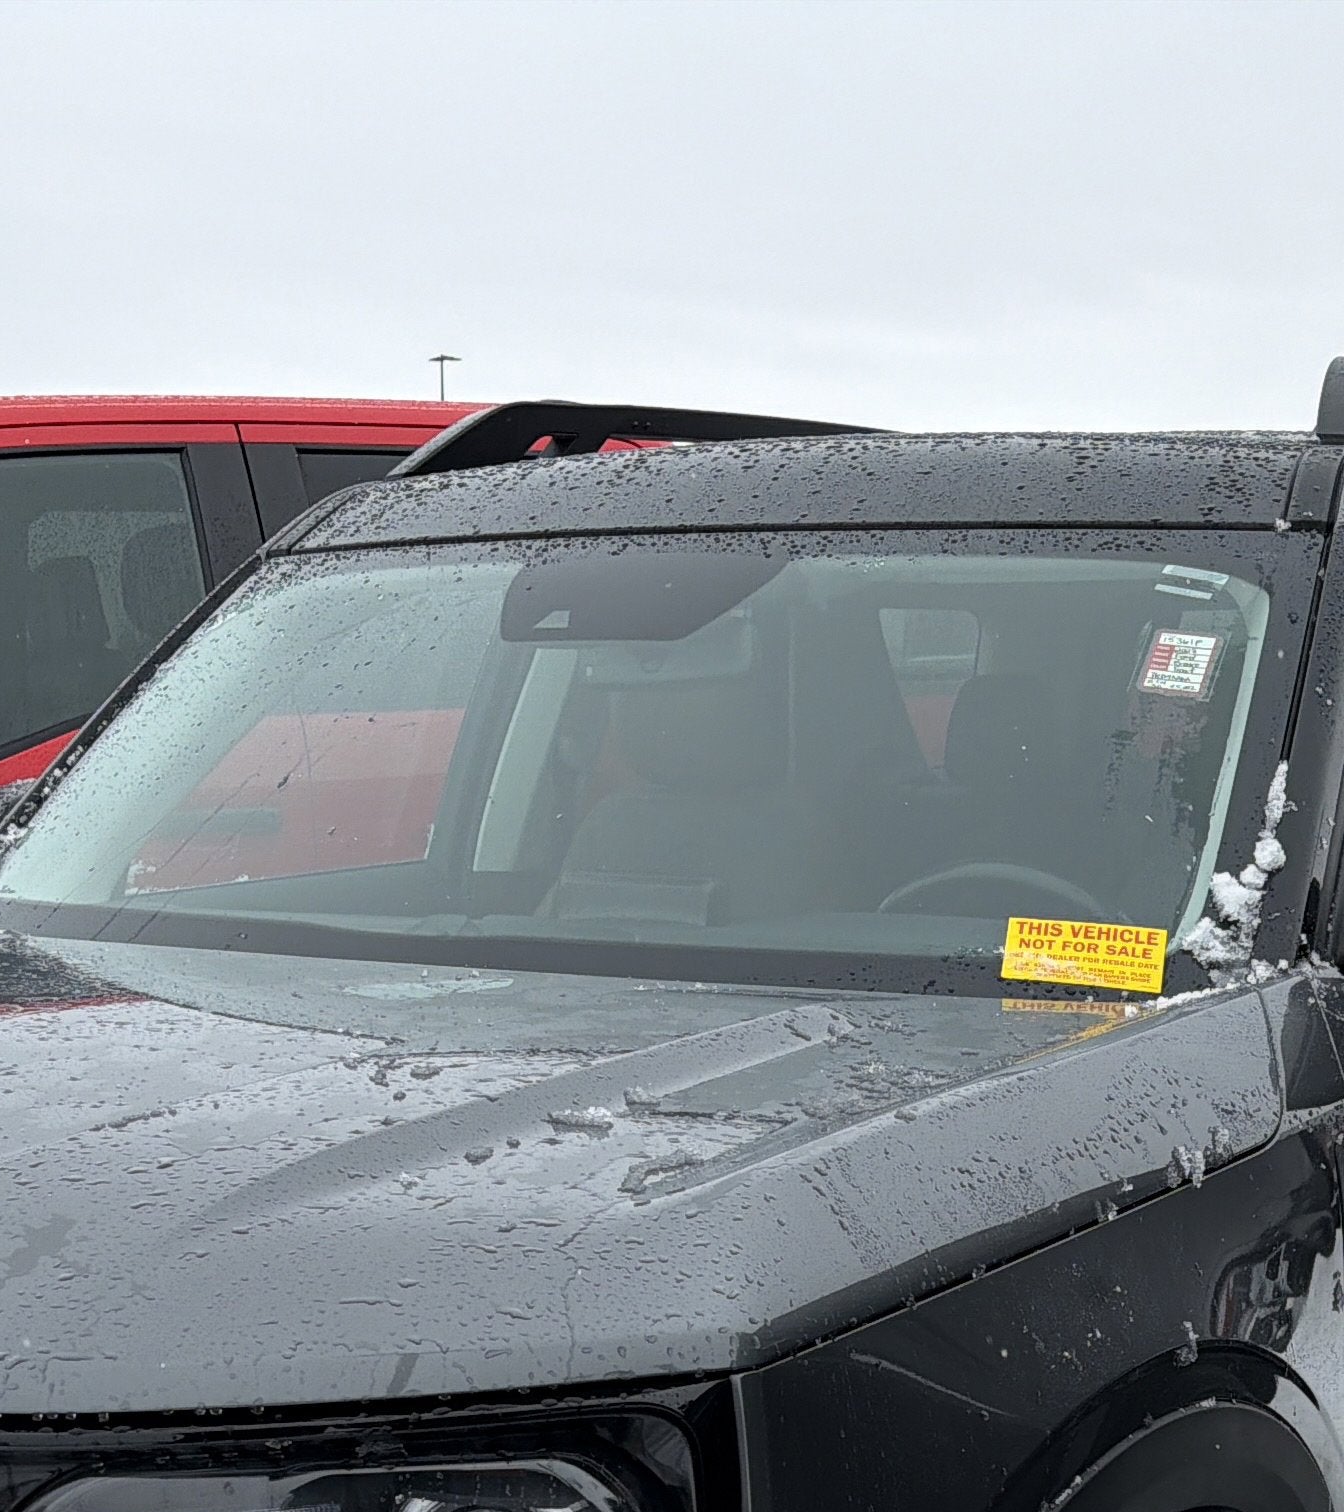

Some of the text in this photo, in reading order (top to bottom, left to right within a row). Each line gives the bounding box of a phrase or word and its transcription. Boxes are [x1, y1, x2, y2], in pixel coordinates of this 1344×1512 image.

[1017, 921, 1160, 945] THIS VEHICLE
[1019, 938, 1153, 959] NOT FOR SALE
[1138, 962, 1159, 970] DATE
